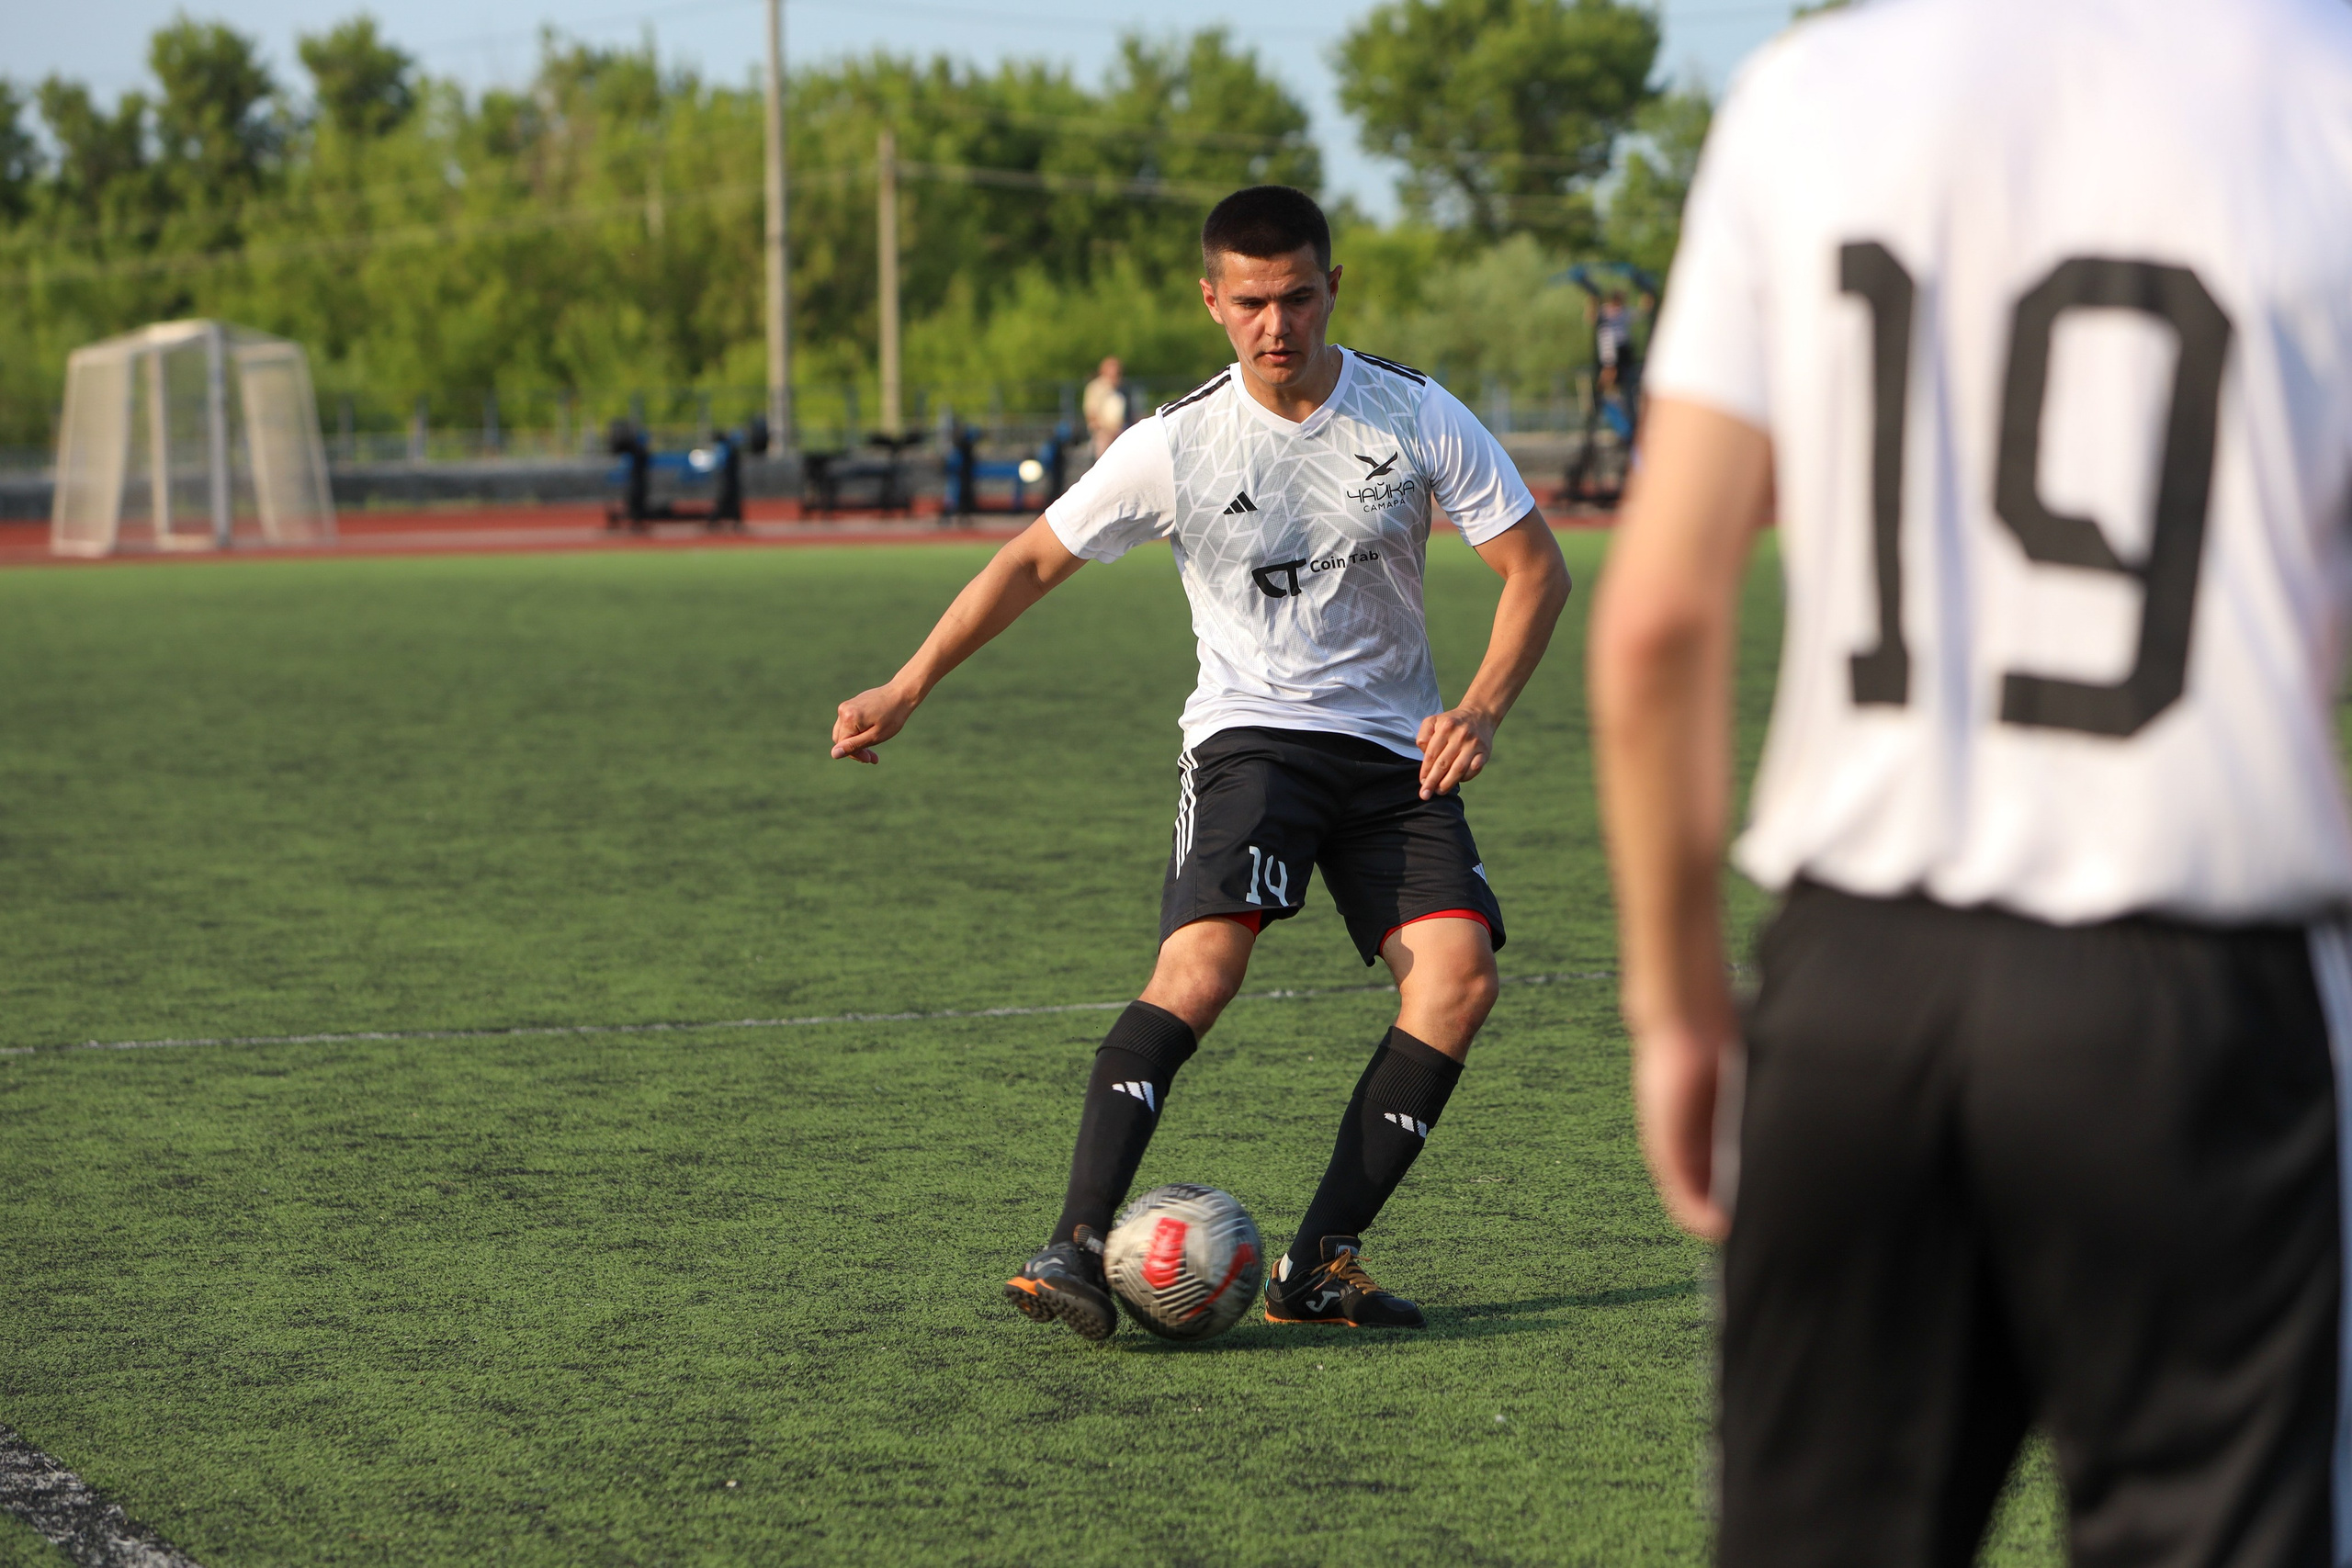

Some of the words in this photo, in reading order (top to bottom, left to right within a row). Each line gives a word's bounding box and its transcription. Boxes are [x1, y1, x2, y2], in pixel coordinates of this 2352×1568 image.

[1346, 479, 1415, 503] ЧАЙКА
[1839, 241, 2236, 739] 19
[1363, 498, 1407, 513] САМАРА
[1309, 556, 1346, 573] Coin
[1349, 550, 1379, 564] Tab
